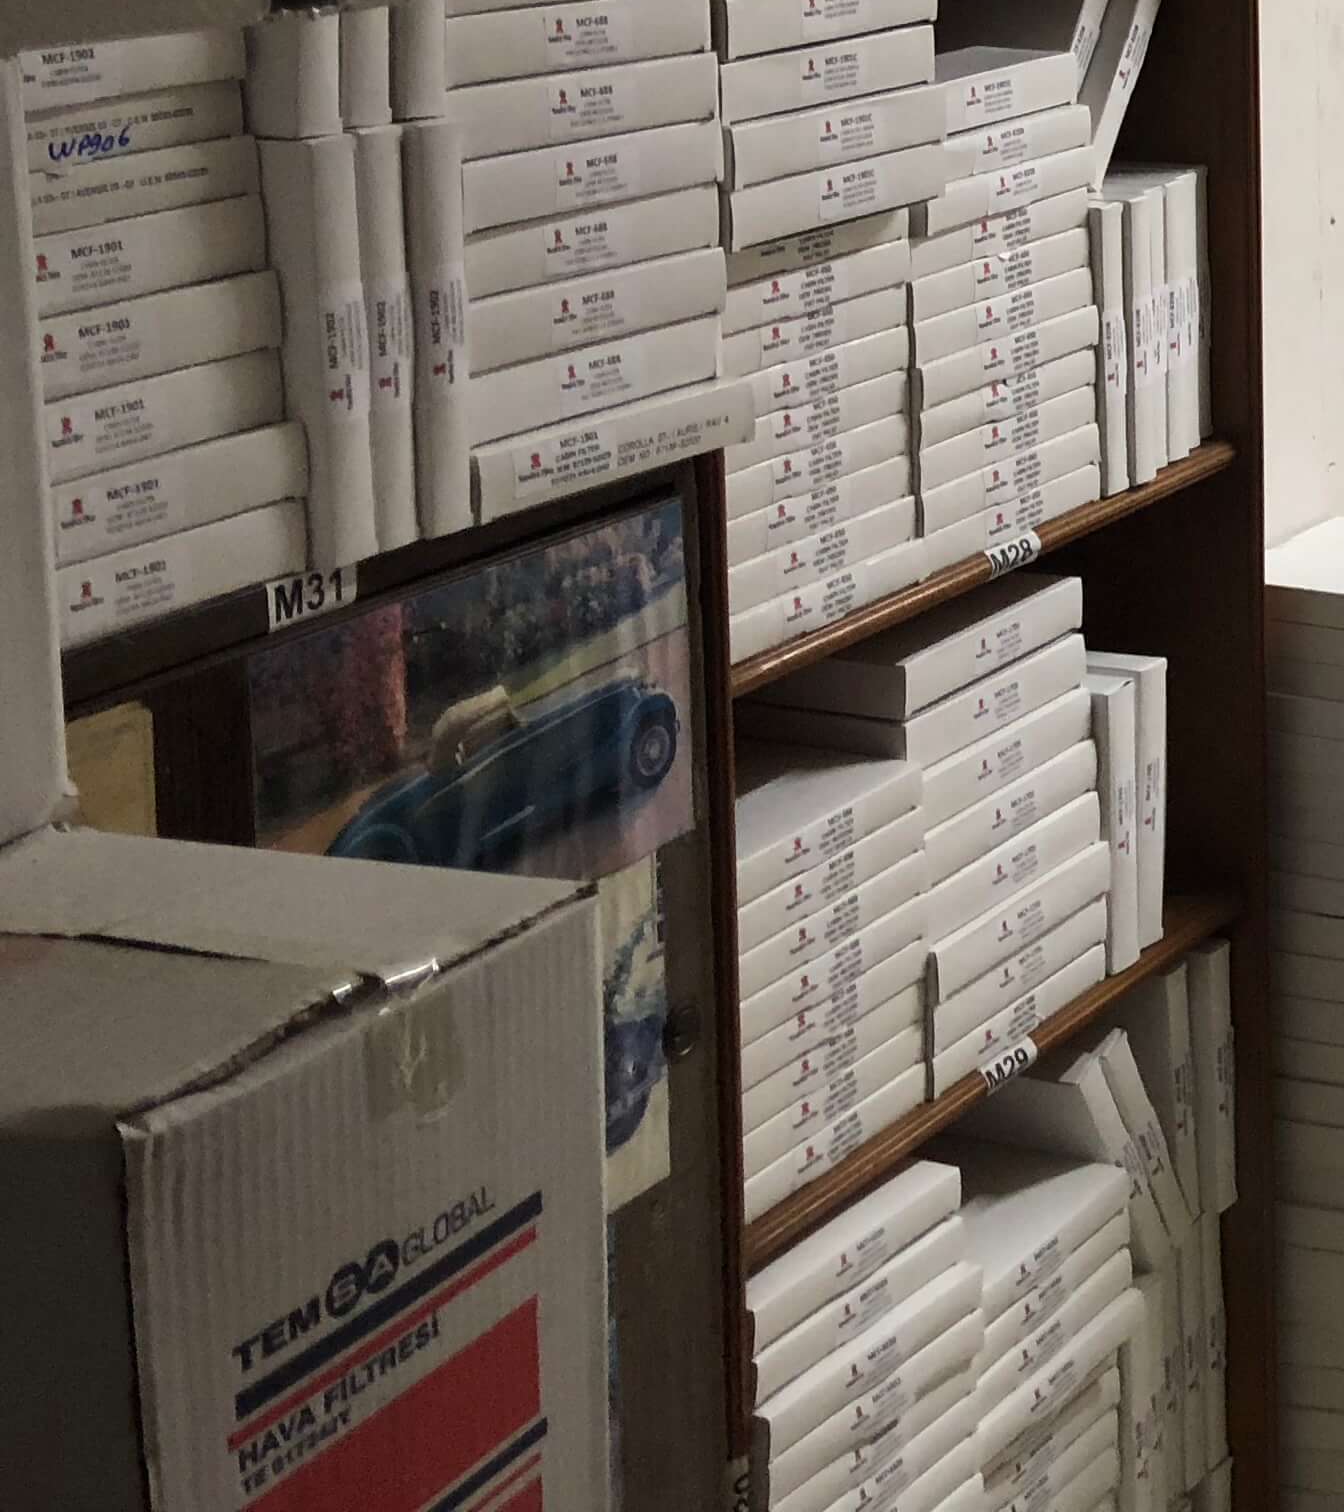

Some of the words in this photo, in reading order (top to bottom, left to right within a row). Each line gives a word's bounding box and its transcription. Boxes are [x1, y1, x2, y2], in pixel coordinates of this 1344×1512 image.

[989, 537, 1035, 573] M28
[274, 567, 342, 624] M31
[985, 1047, 1029, 1090] M29
[401, 1185, 496, 1266] GLOBAL
[238, 1403, 317, 1473] HAVA
